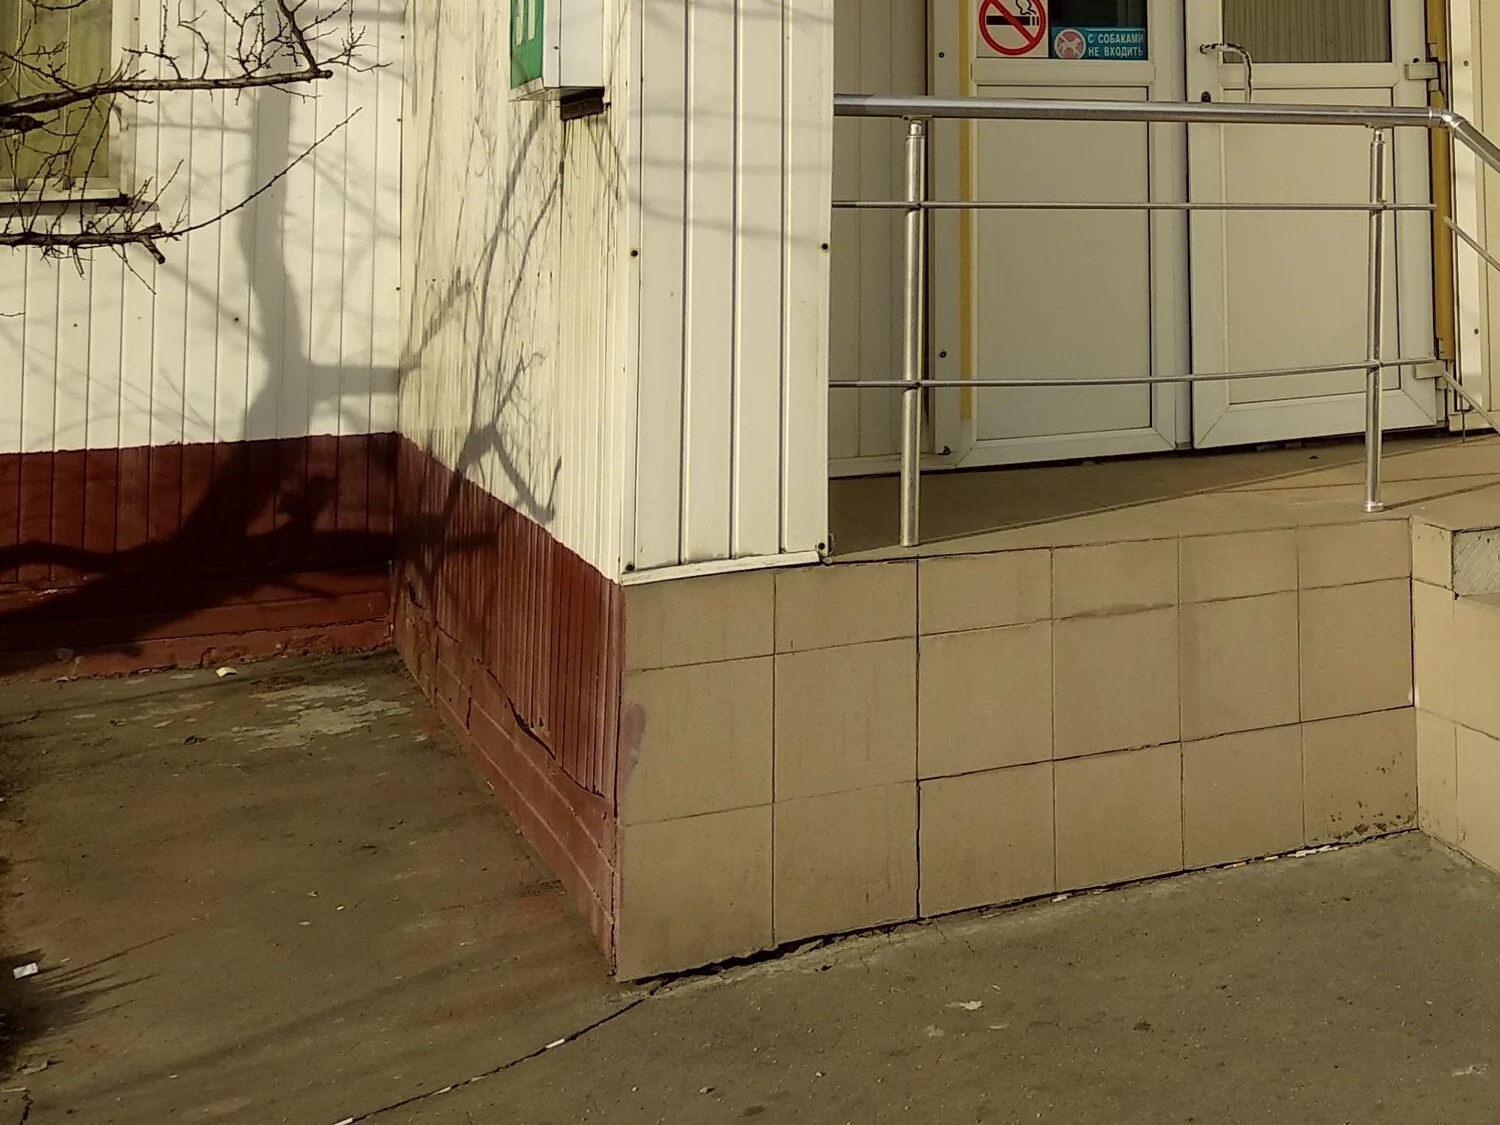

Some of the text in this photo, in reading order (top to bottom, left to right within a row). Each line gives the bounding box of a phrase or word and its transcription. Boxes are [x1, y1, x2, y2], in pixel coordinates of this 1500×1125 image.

[1087, 33, 1144, 44] С СОБАКАМИ
[1088, 46, 1144, 58] НЕ ВХОДИТЬ
